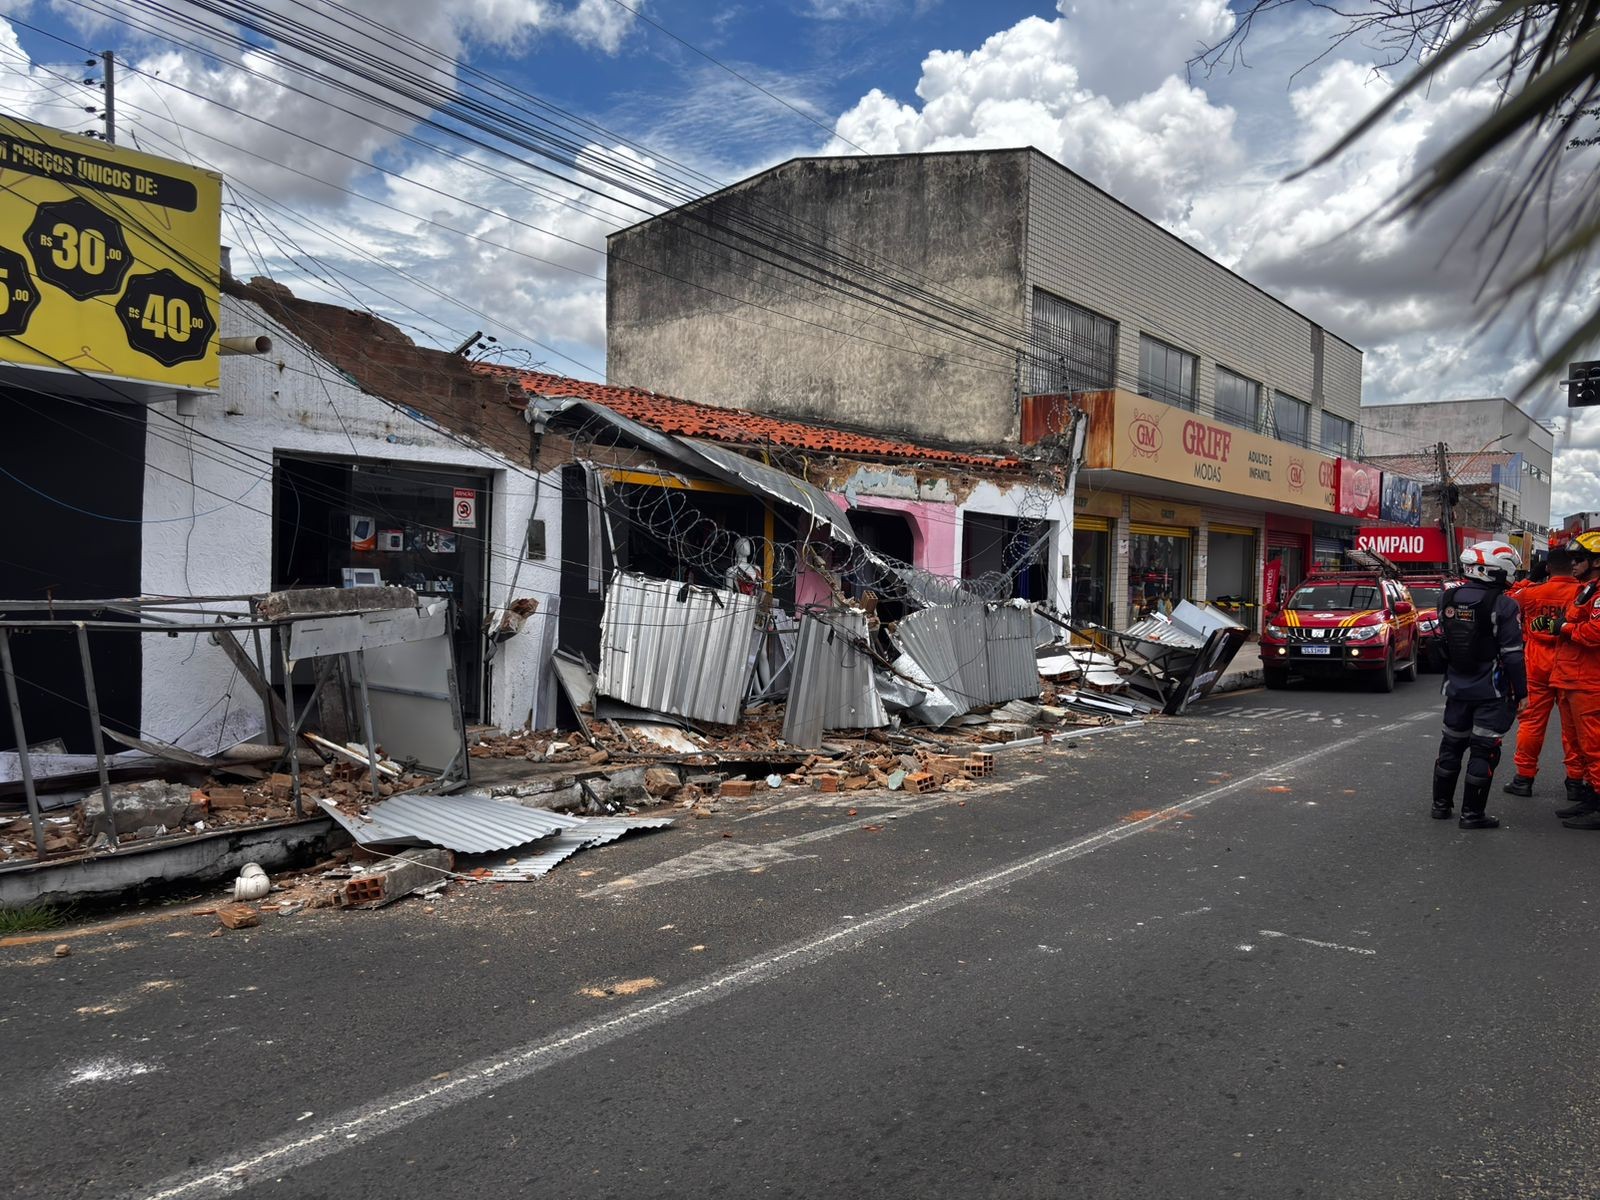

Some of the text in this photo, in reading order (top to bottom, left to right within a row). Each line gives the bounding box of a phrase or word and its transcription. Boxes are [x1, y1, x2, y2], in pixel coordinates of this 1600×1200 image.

[12, 143, 73, 176] PREÇOS
[77, 157, 131, 191] ÚNICOS
[135, 174, 158, 196] DE:
[1137, 424, 1157, 448] GM
[1182, 419, 1232, 463] GRIFF
[1248, 450, 1269, 465] ADULTO
[1193, 462, 1222, 483] MODAS
[1248, 467, 1272, 482] INFANTIL
[1358, 535, 1424, 554] SAMPAIO
